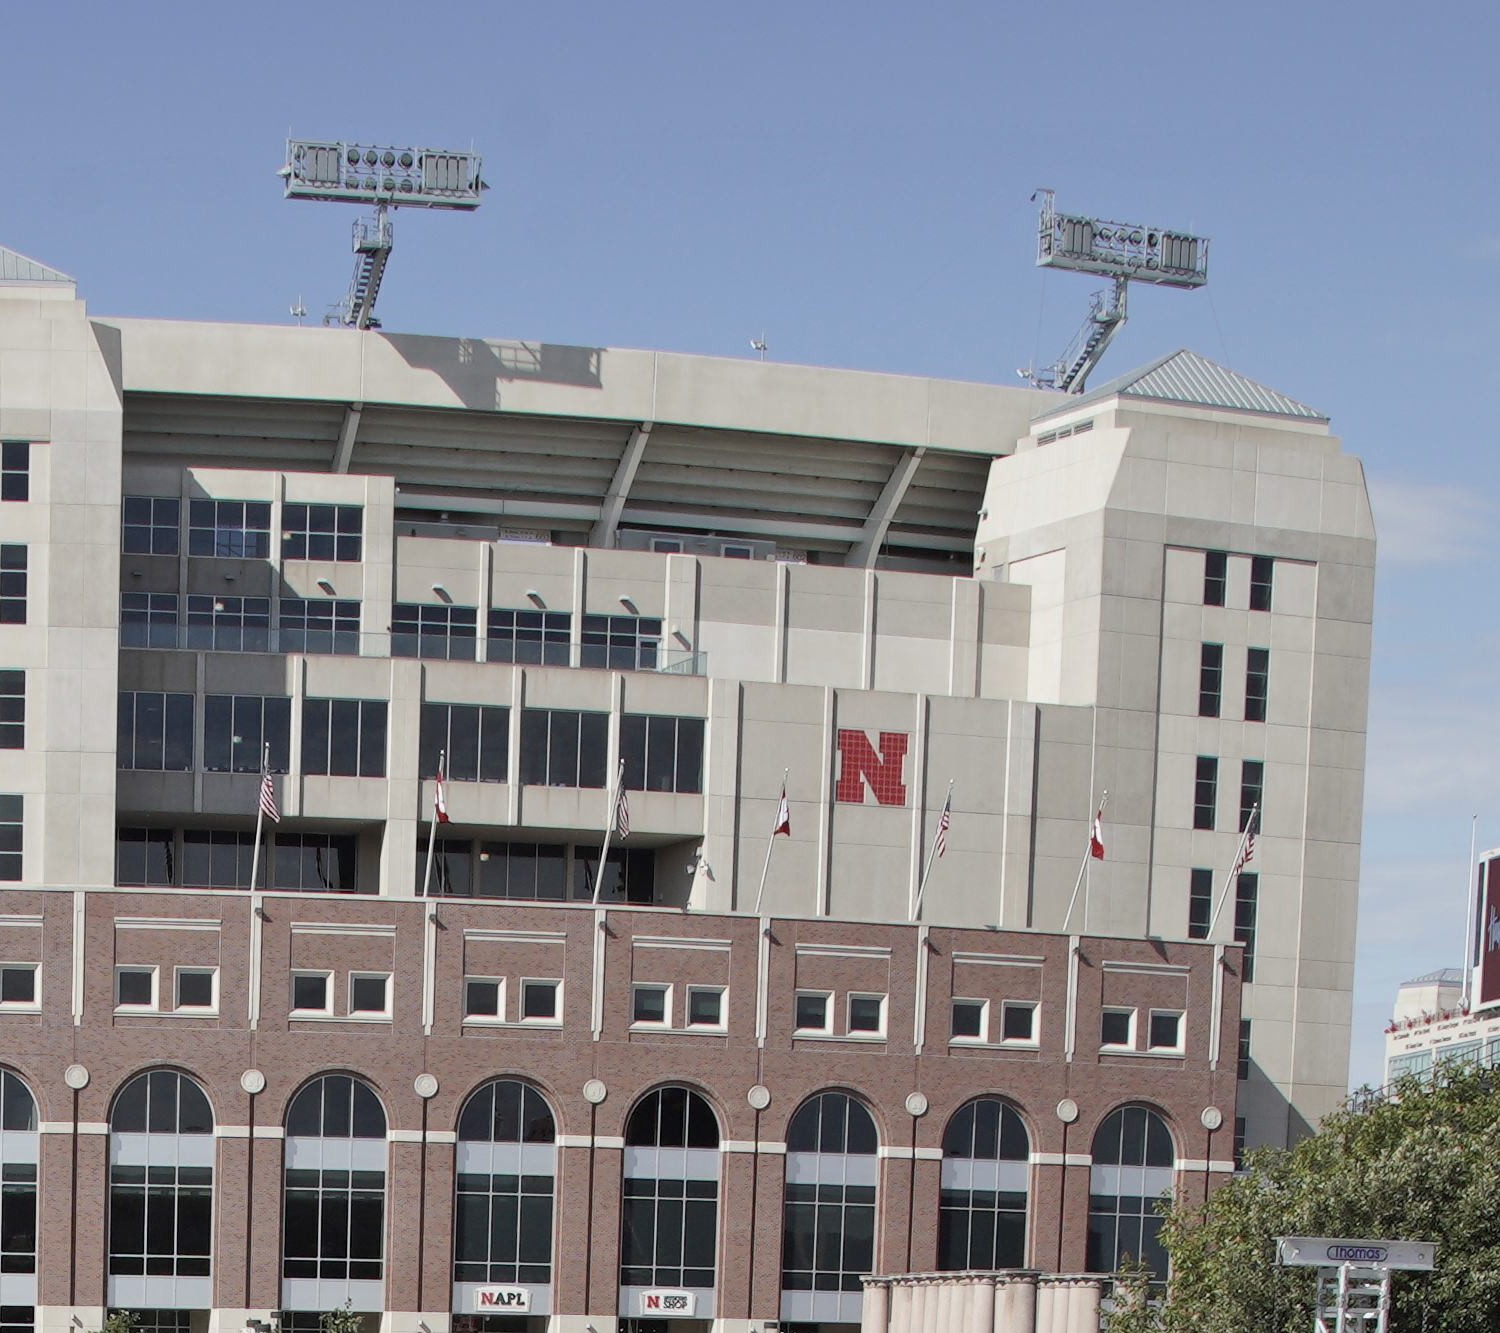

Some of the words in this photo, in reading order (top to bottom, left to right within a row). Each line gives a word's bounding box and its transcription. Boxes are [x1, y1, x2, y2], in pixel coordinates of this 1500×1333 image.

[836, 728, 908, 806] N
[481, 1292, 526, 1306] NAPL
[647, 1296, 661, 1309] N
